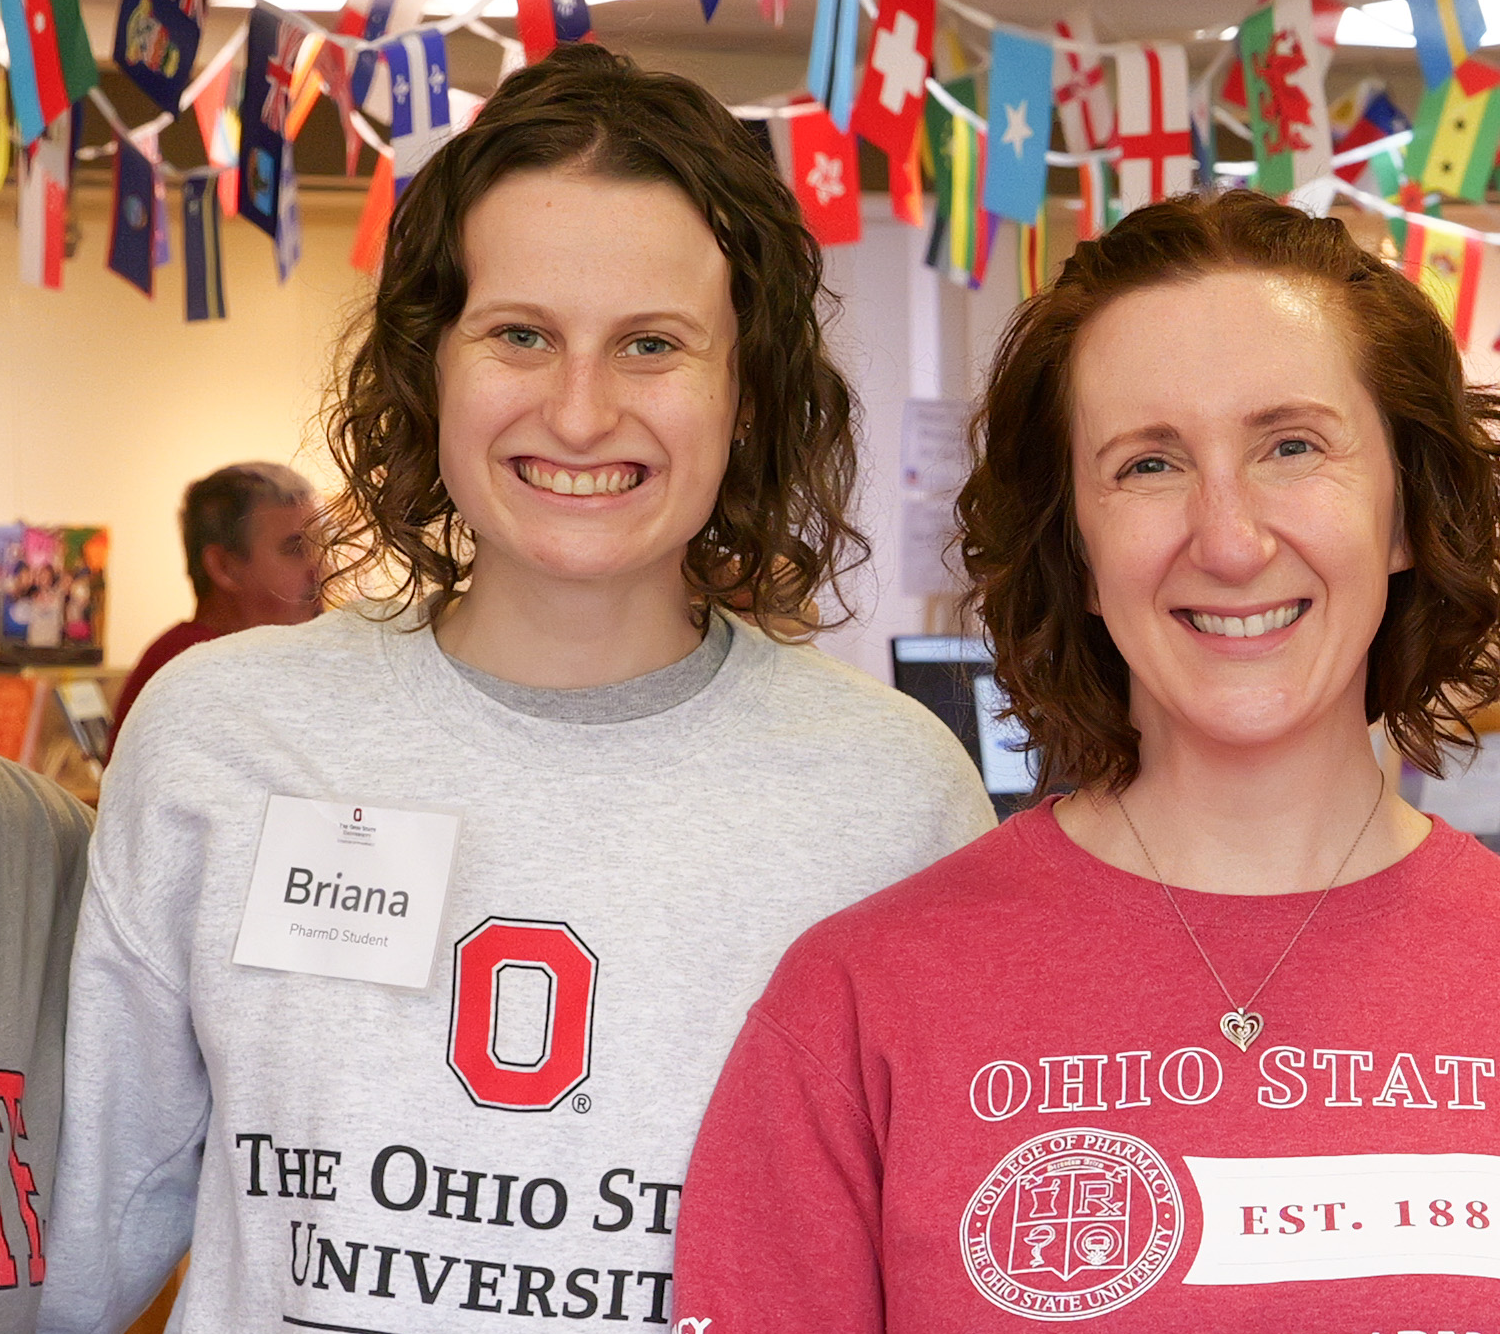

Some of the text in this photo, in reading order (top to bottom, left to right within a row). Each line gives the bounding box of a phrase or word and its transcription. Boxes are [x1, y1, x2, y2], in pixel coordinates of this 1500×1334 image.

[284, 867, 409, 917] Briana
[289, 923, 389, 947] PharmD Student
[969, 1045, 1223, 1122] OHIO
[236, 1133, 682, 1234] THE OHIO ST
[975, 1135, 1174, 1216] COLLEGE OF PHARMACY
[1239, 1202, 1364, 1237] EST.
[290, 1220, 675, 1323] UNIVERSIT
[969, 1226, 1174, 1312] THE OHIO STATE UNIVERSITY
